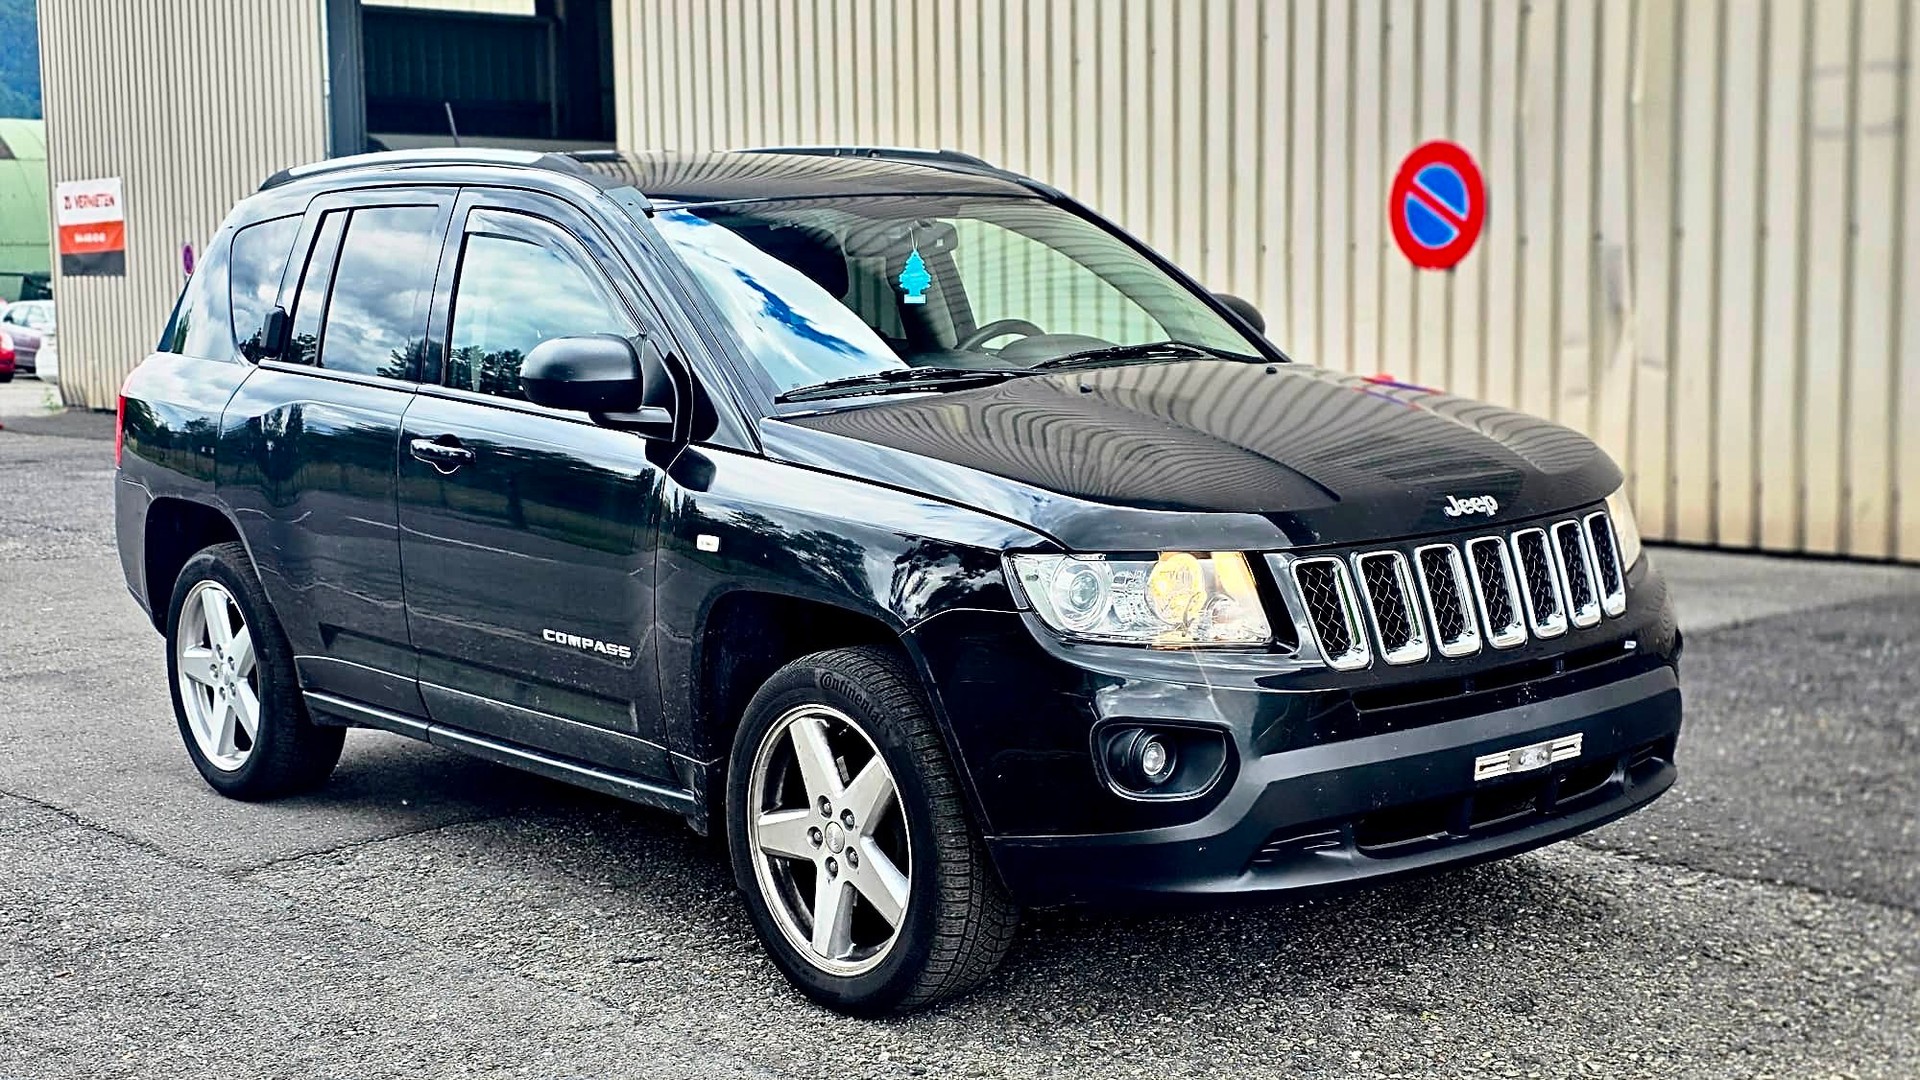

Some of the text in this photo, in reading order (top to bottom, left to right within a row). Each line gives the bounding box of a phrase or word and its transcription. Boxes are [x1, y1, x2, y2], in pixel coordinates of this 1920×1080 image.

[1444, 495, 1499, 517] Jeep
[543, 629, 632, 658] COMPASS
[820, 671, 885, 728] Continental
